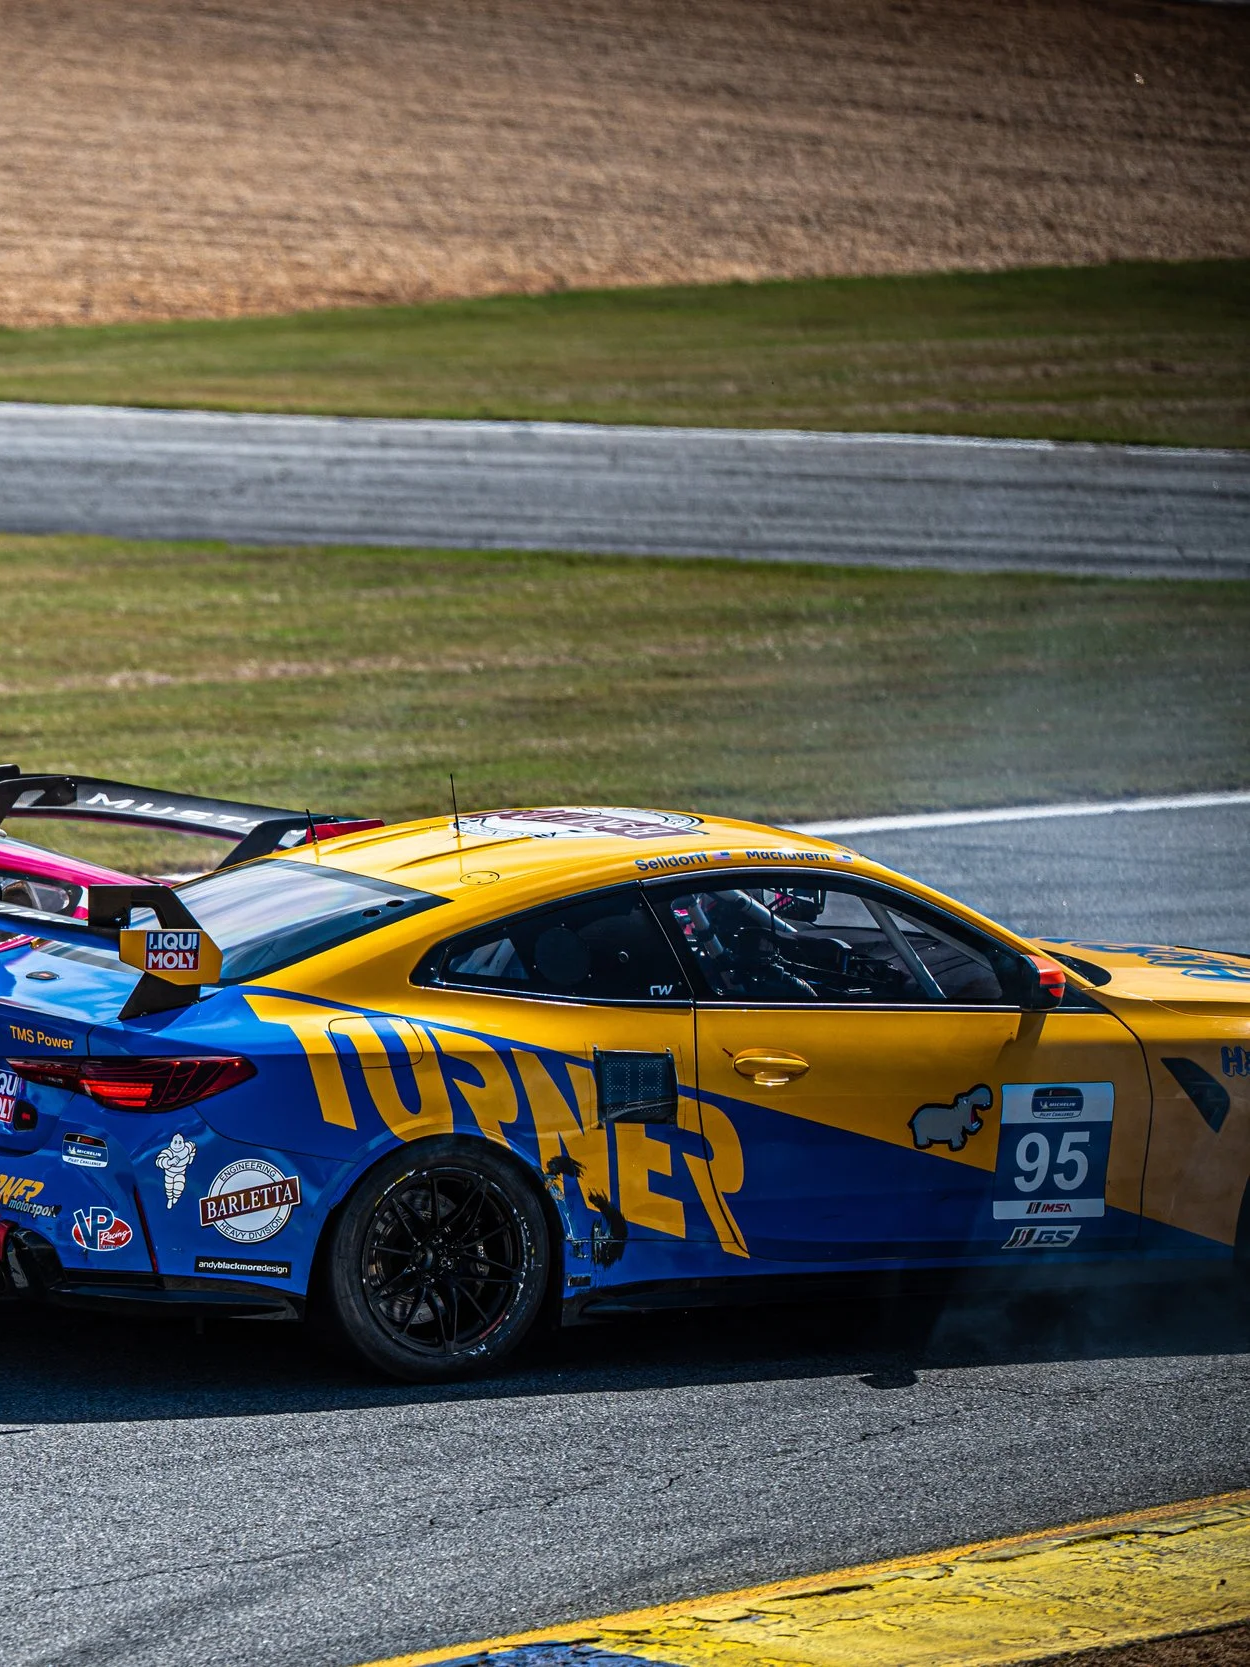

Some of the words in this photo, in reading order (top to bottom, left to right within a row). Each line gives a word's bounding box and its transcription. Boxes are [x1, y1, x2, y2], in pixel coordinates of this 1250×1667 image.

[635, 851, 709, 871] Selldorff
[149, 932, 198, 952] LIQUI
[147, 952, 196, 969] MOLY
[10, 1025, 34, 1044] TMS
[37, 1030, 74, 1050] Power
[243, 994, 751, 1259] TURNER
[76, 1149, 102, 1158] MICHELIN
[1014, 1131, 1090, 1193] 95
[219, 1162, 277, 1182] ENGINEERING
[8, 1197, 56, 1218] motorsport
[206, 1183, 293, 1219] BARLETTA
[1041, 1203, 1072, 1213] IMSA
[73, 1207, 115, 1250] VP
[100, 1227, 131, 1245] Racing
[219, 1222, 246, 1239] HEAVY
[249, 1215, 284, 1239] DIVISION
[1033, 1230, 1075, 1245] GS
[198, 1260, 288, 1275] andyblackmoredesign
